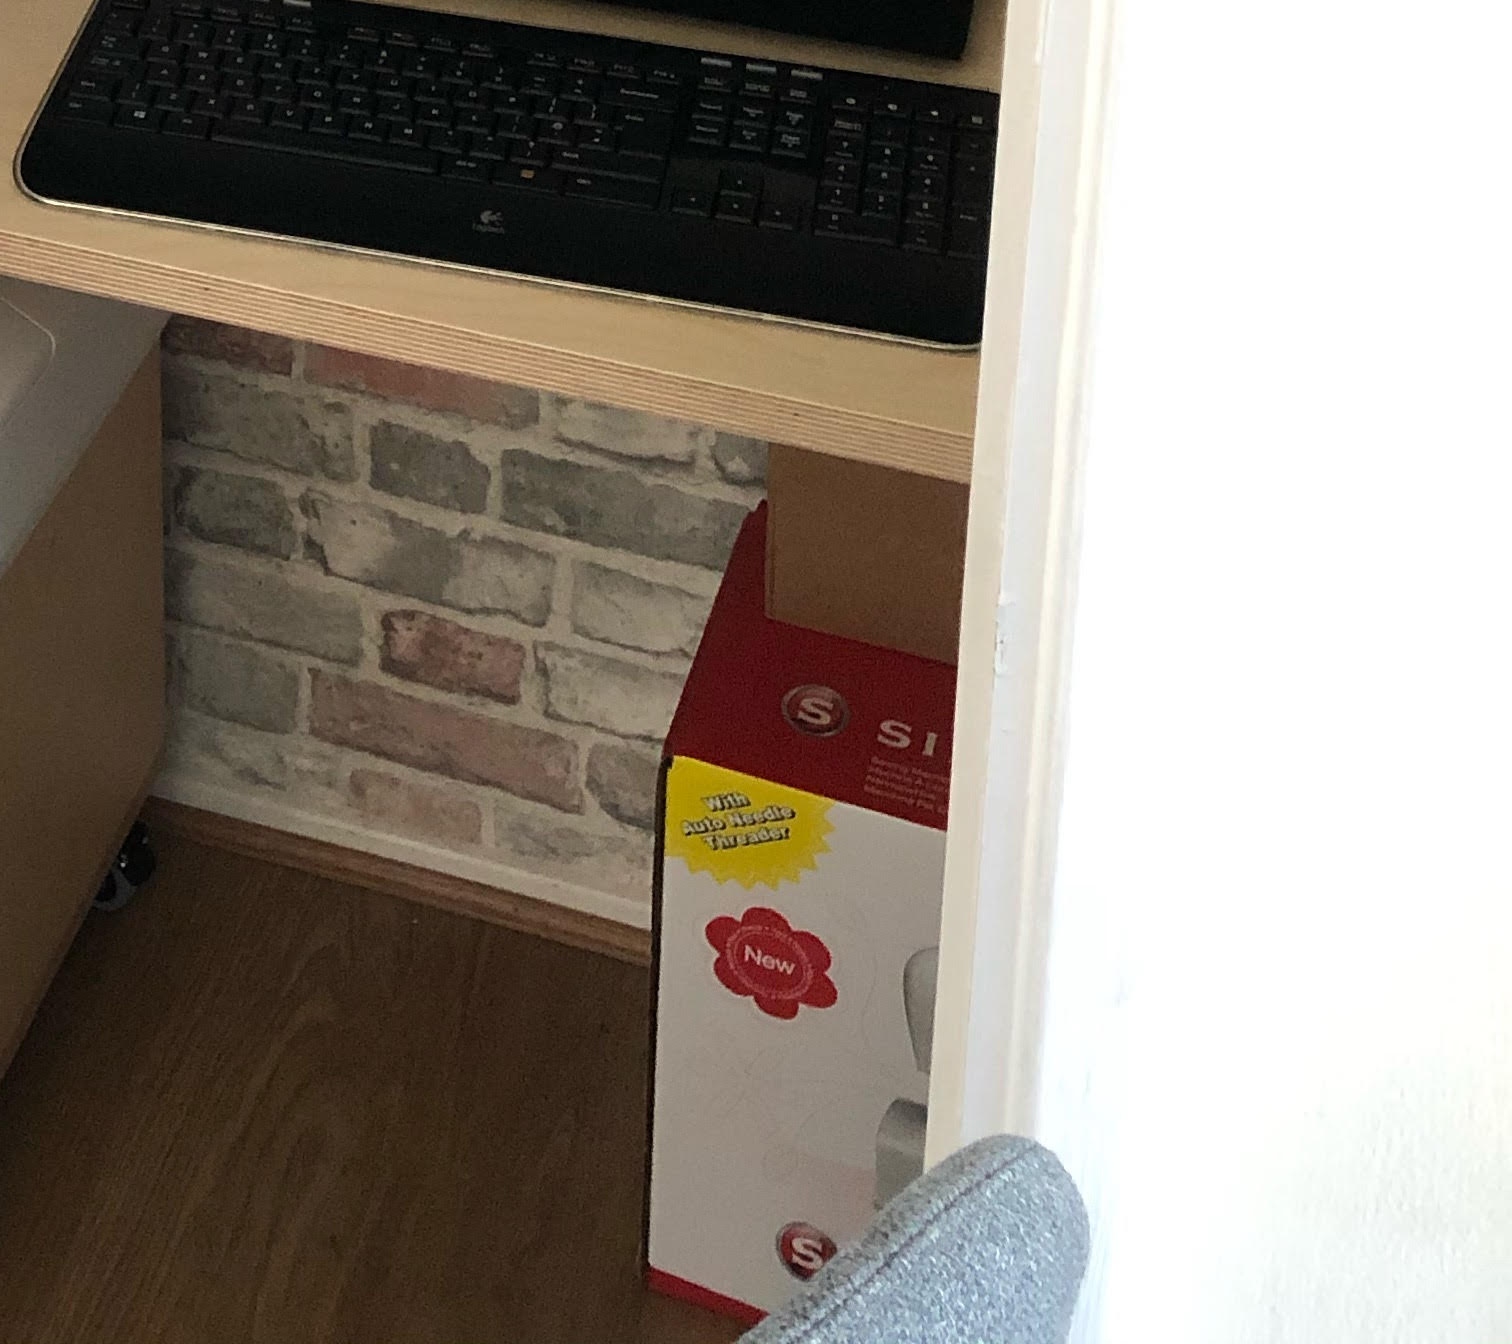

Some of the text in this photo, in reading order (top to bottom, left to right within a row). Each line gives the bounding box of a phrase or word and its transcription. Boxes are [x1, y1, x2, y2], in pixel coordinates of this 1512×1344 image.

[875, 718, 939, 758] SI
[700, 792, 752, 813] With
[681, 804, 797, 837] Auto Needle
[703, 826, 791, 852] Threader
[743, 944, 796, 976] New
